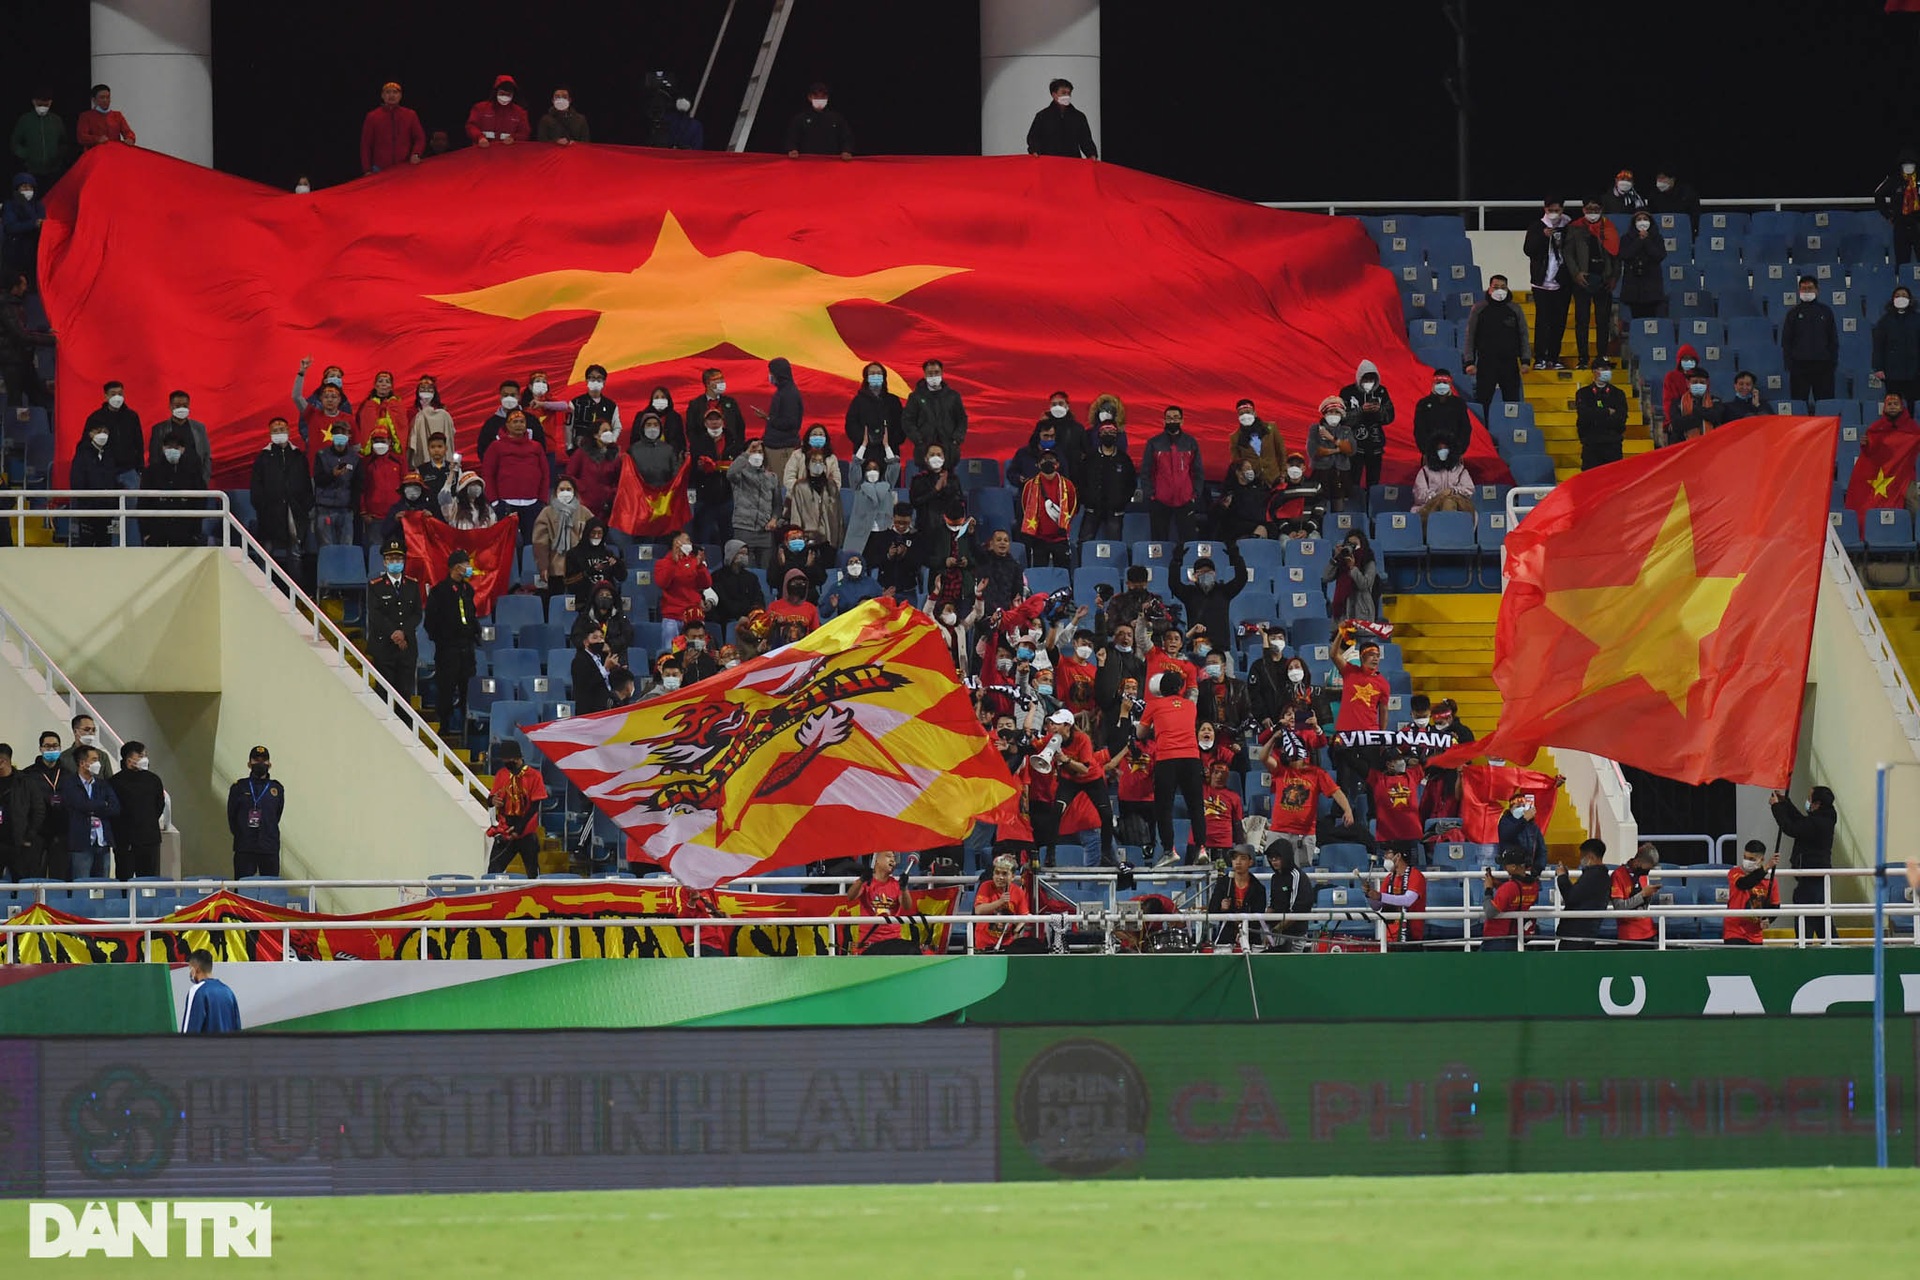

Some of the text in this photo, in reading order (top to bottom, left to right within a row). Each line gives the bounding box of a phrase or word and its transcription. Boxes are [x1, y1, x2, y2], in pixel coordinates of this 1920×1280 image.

[787, 664, 891, 714] STAR
[772, 717, 796, 734] 2017
[1339, 730, 1452, 748] VIETNAM
[1310, 1062, 1484, 1142] PHÊ
[1509, 1074, 1902, 1138] PHINDELI
